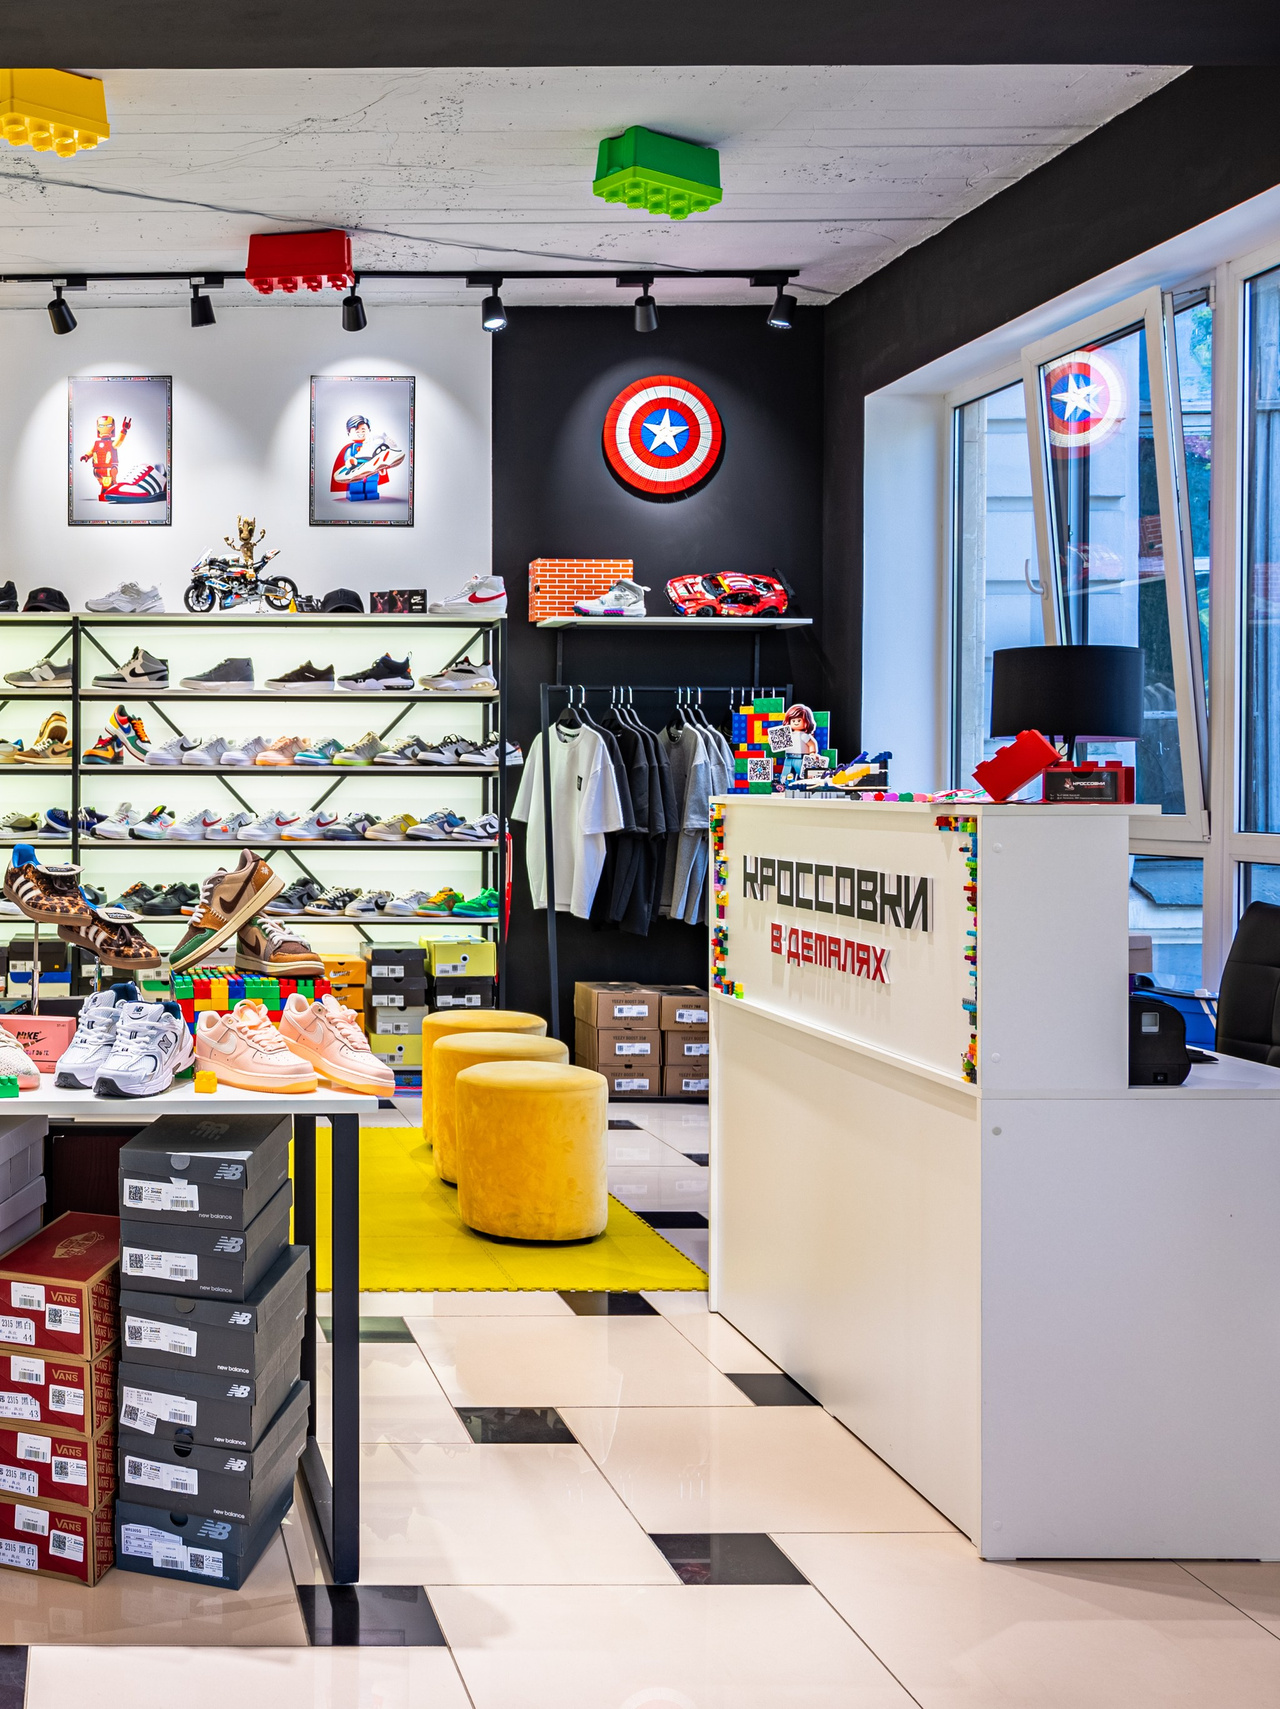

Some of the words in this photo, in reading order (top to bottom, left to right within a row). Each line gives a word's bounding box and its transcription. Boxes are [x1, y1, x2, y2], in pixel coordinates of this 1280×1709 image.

[742, 854, 932, 932] КРОССОВКИ
[770, 922, 785, 956] В
[786, 926, 890, 985] ДЕТАЛЯХ
[16, 1031, 41, 1040] NIKE
[211, 1286, 233, 1294] balance
[50, 1291, 77, 1304] VANS
[1, 1319, 13, 1328] 2315
[23, 1333, 32, 1342] 44
[228, 1365, 250, 1374] balance
[52, 1369, 79, 1382] VANS
[7, 1396, 18, 1404] 2315
[29, 1410, 39, 1418] 43
[225, 1437, 247, 1446] balance
[55, 1443, 82, 1457] VANS
[5, 1469, 17, 1478] 2315
[26, 1485, 35, 1494] 41
[224, 1509, 246, 1519] balance
[55, 1518, 81, 1532] VANS
[5, 1543, 16, 1552] 2315
[26, 1558, 36, 1567] 37
